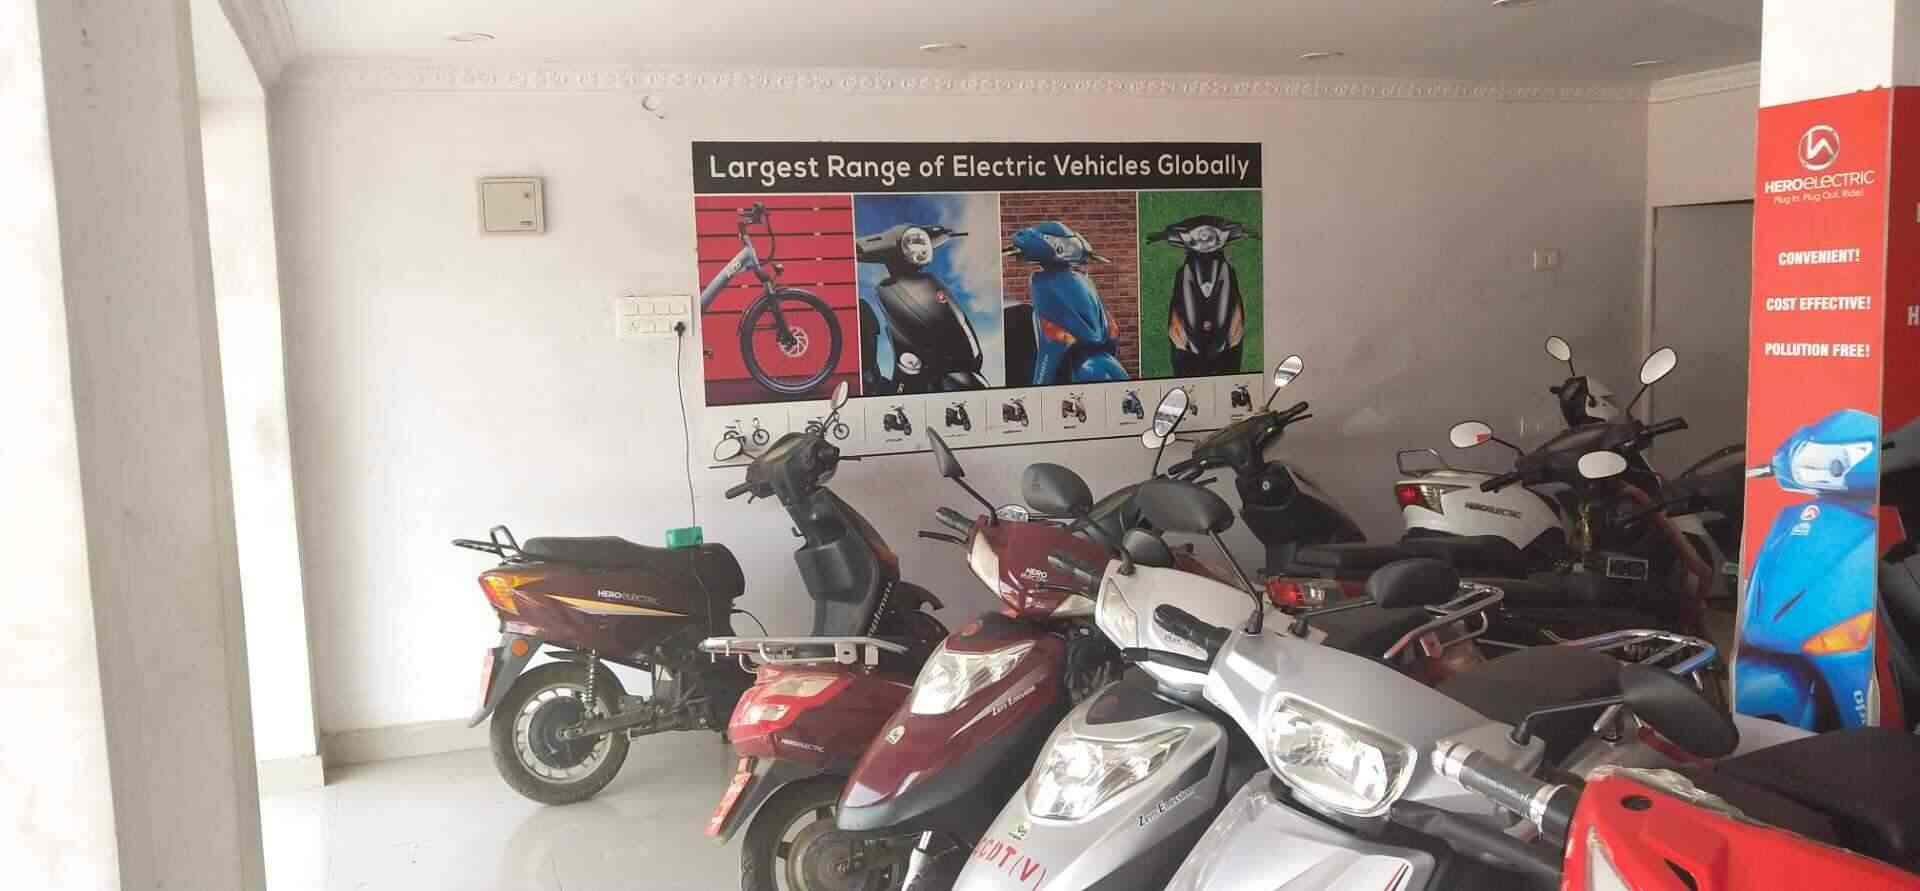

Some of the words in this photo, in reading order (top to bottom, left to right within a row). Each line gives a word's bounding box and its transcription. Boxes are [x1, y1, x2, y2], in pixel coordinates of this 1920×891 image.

[709, 154, 819, 187] Largest
[827, 155, 911, 186] Range
[919, 155, 945, 178] of
[952, 155, 1047, 177] Electric
[1053, 154, 1151, 176] Vehicles
[1157, 154, 1249, 180] Globally
[1778, 248, 1861, 266] CONVENIENT!
[1766, 297, 1798, 311] COST
[1800, 295, 1872, 311] EFFECTIVE!
[1764, 343, 1830, 357] POLLUTION
[1832, 343, 1871, 358] FREE!
